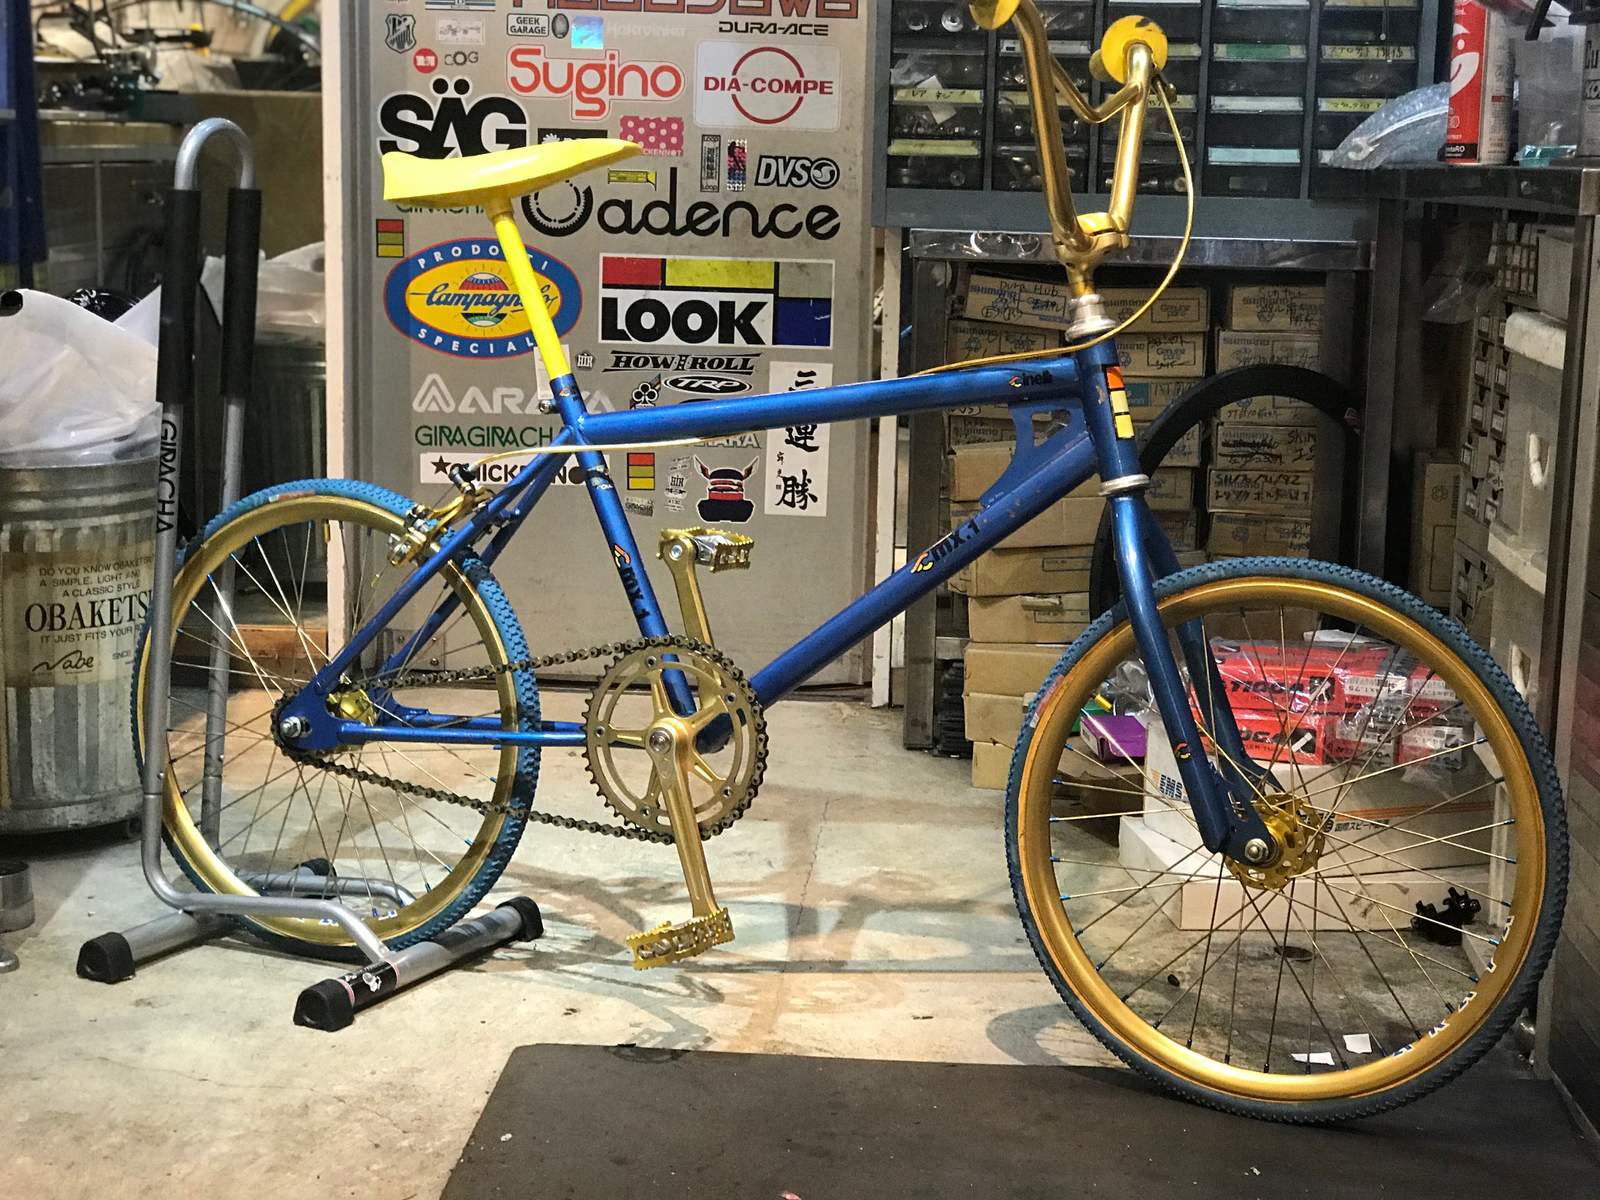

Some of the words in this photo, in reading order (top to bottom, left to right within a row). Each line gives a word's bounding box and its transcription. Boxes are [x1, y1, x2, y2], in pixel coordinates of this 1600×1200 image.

[510, 25, 547, 35] GARAGE
[516, 16, 540, 25] GEEK
[718, 21, 829, 36] DURA-ACE
[510, 48, 682, 117] Sugino
[704, 76, 834, 95] DIA-COMPE
[757, 157, 811, 186] DVS
[409, 283, 559, 317] Campagnlo
[601, 297, 768, 345] LOOK
[417, 328, 534, 353] SPECIAL
[611, 354, 677, 370] HOW
[688, 355, 755, 371] ROLL
[672, 377, 742, 391] TRP
[415, 425, 560, 447] GIRAGIRACH
[156, 419, 177, 533] GIRACHA
[39, 567, 55, 577] DO
[58, 566, 81, 576] YOU
[83, 563, 112, 574] KNOW
[39, 578, 48, 588] A
[62, 590, 70, 598] A
[72, 585, 114, 597] CLASSIC
[40, 635, 51, 644] IT
[54, 633, 82, 644] JUST
[85, 630, 107, 641] FITS
[109, 625, 133, 638] YOUR
